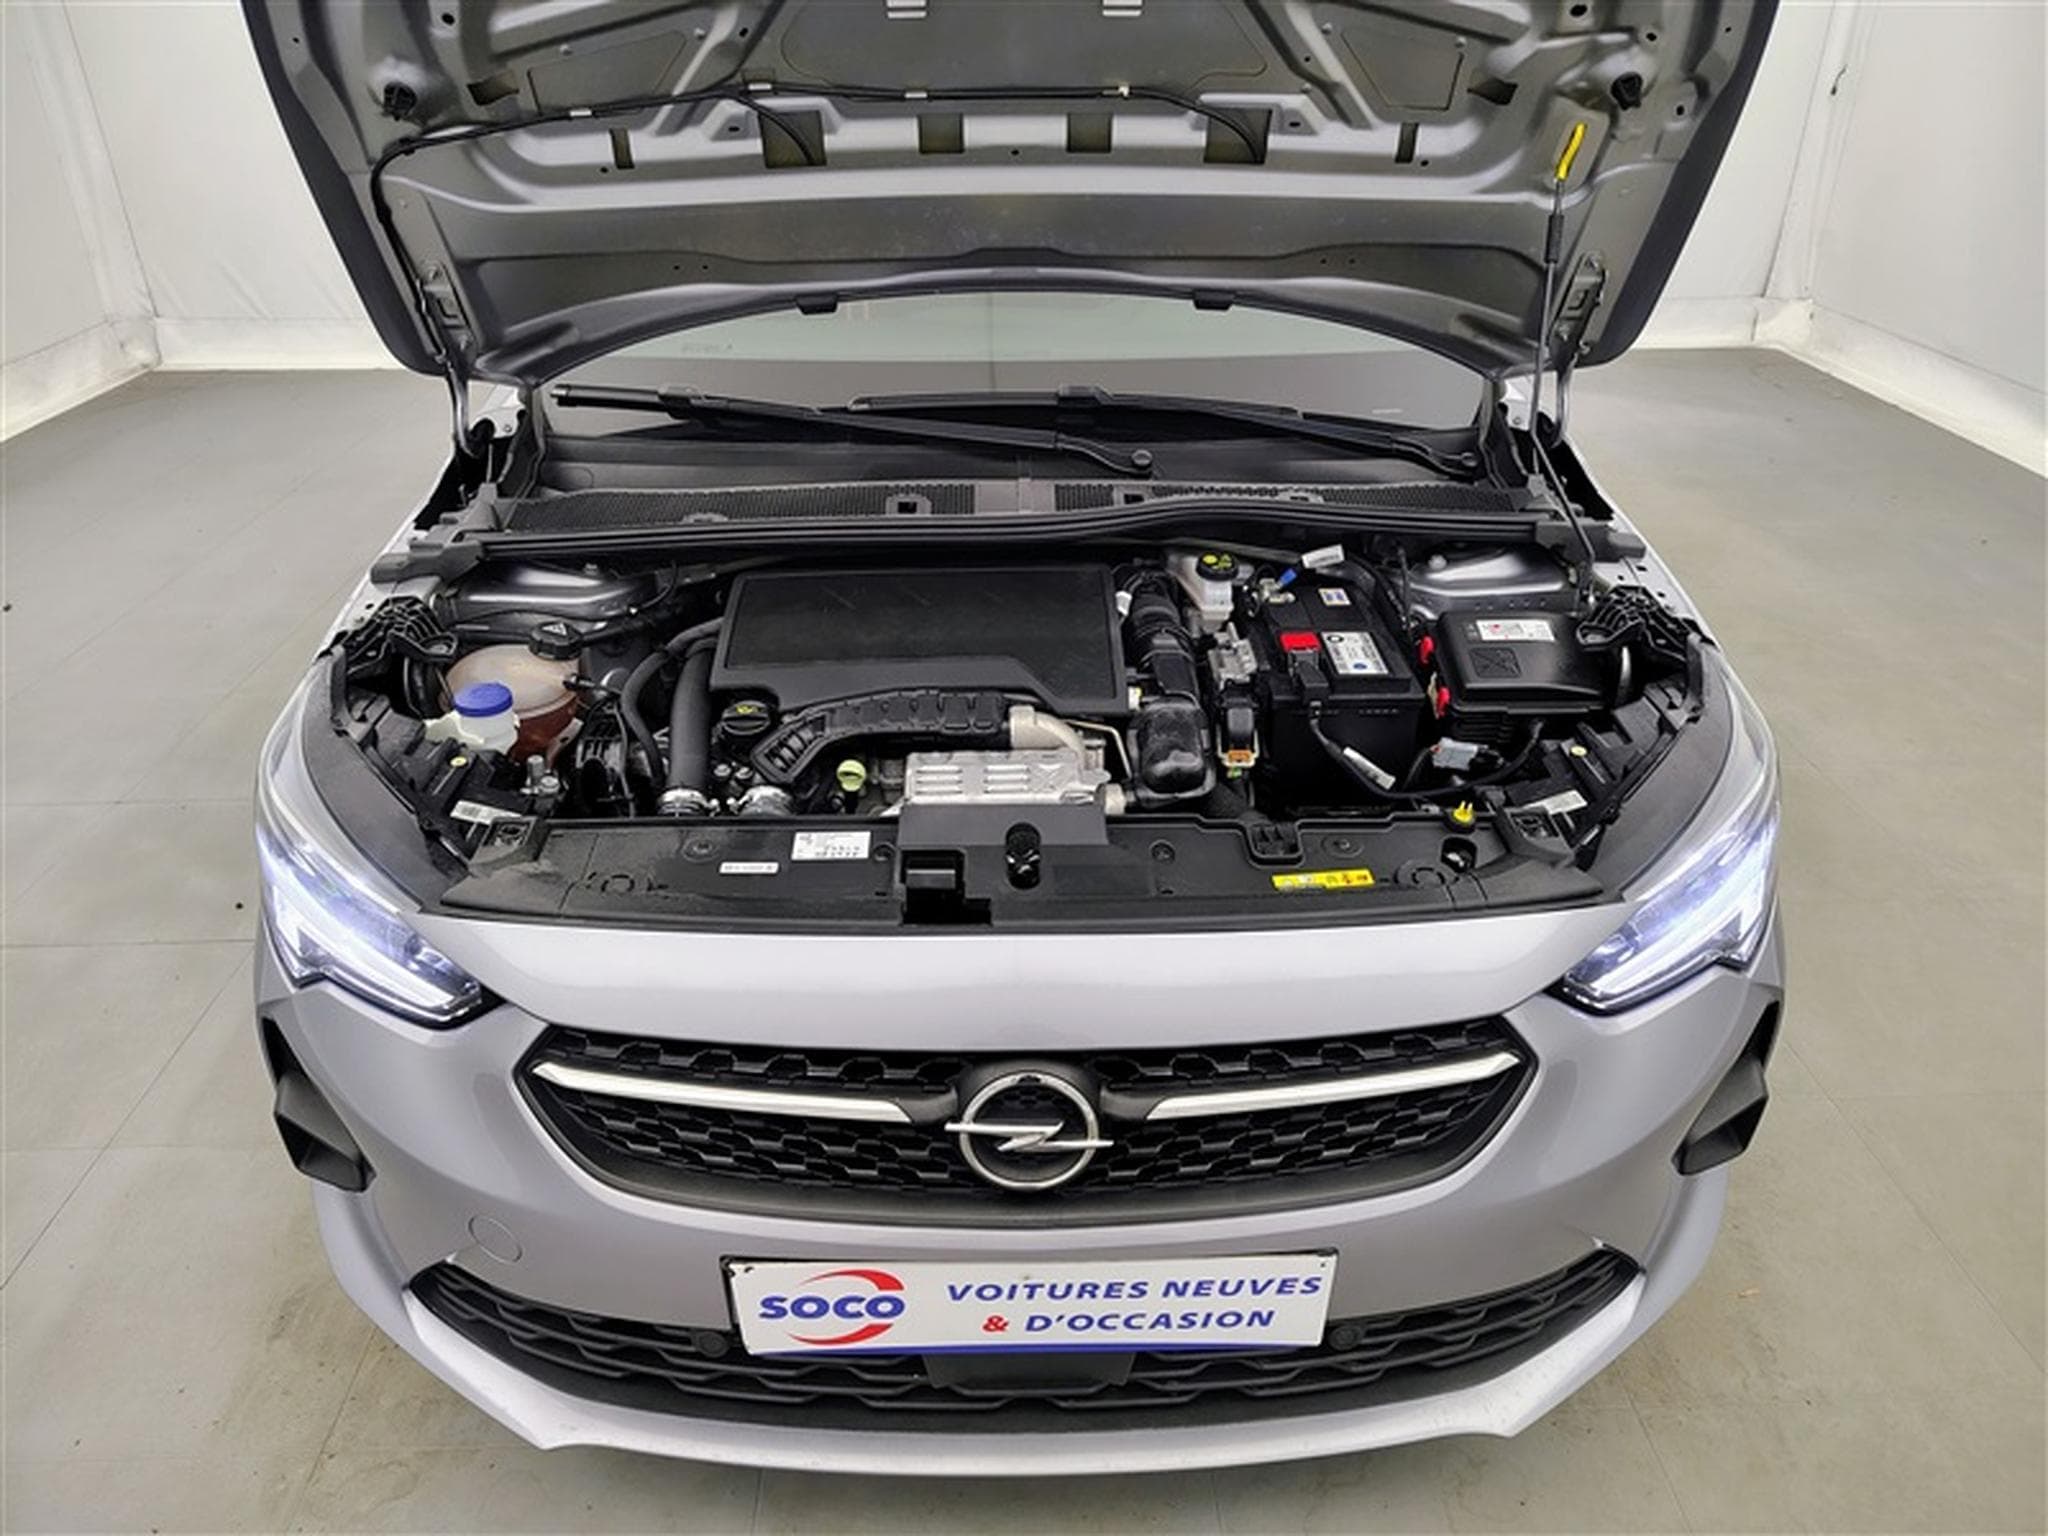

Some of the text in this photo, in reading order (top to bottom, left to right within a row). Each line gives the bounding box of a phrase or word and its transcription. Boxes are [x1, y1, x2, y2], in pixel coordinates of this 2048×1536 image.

[948, 1276, 1322, 1301] VOITURES NEUVES
[759, 1295, 905, 1319] SOCO
[982, 1310, 1274, 1332] & D'OCCASION
